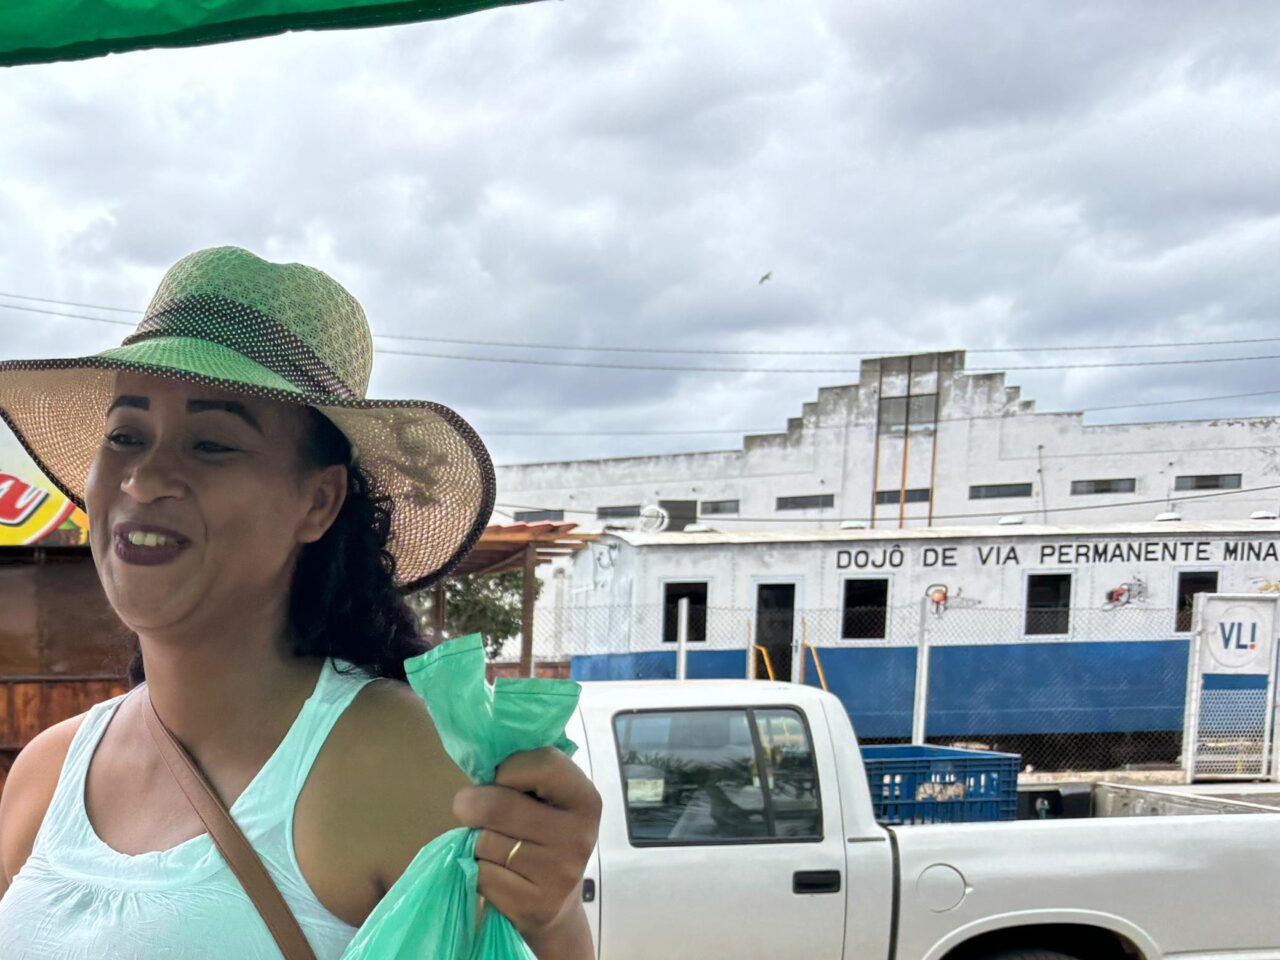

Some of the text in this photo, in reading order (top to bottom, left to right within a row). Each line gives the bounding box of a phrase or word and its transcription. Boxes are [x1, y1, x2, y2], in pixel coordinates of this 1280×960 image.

[836, 541, 1279, 569] DOJÔ DE VIA PERMANENTE MINA
